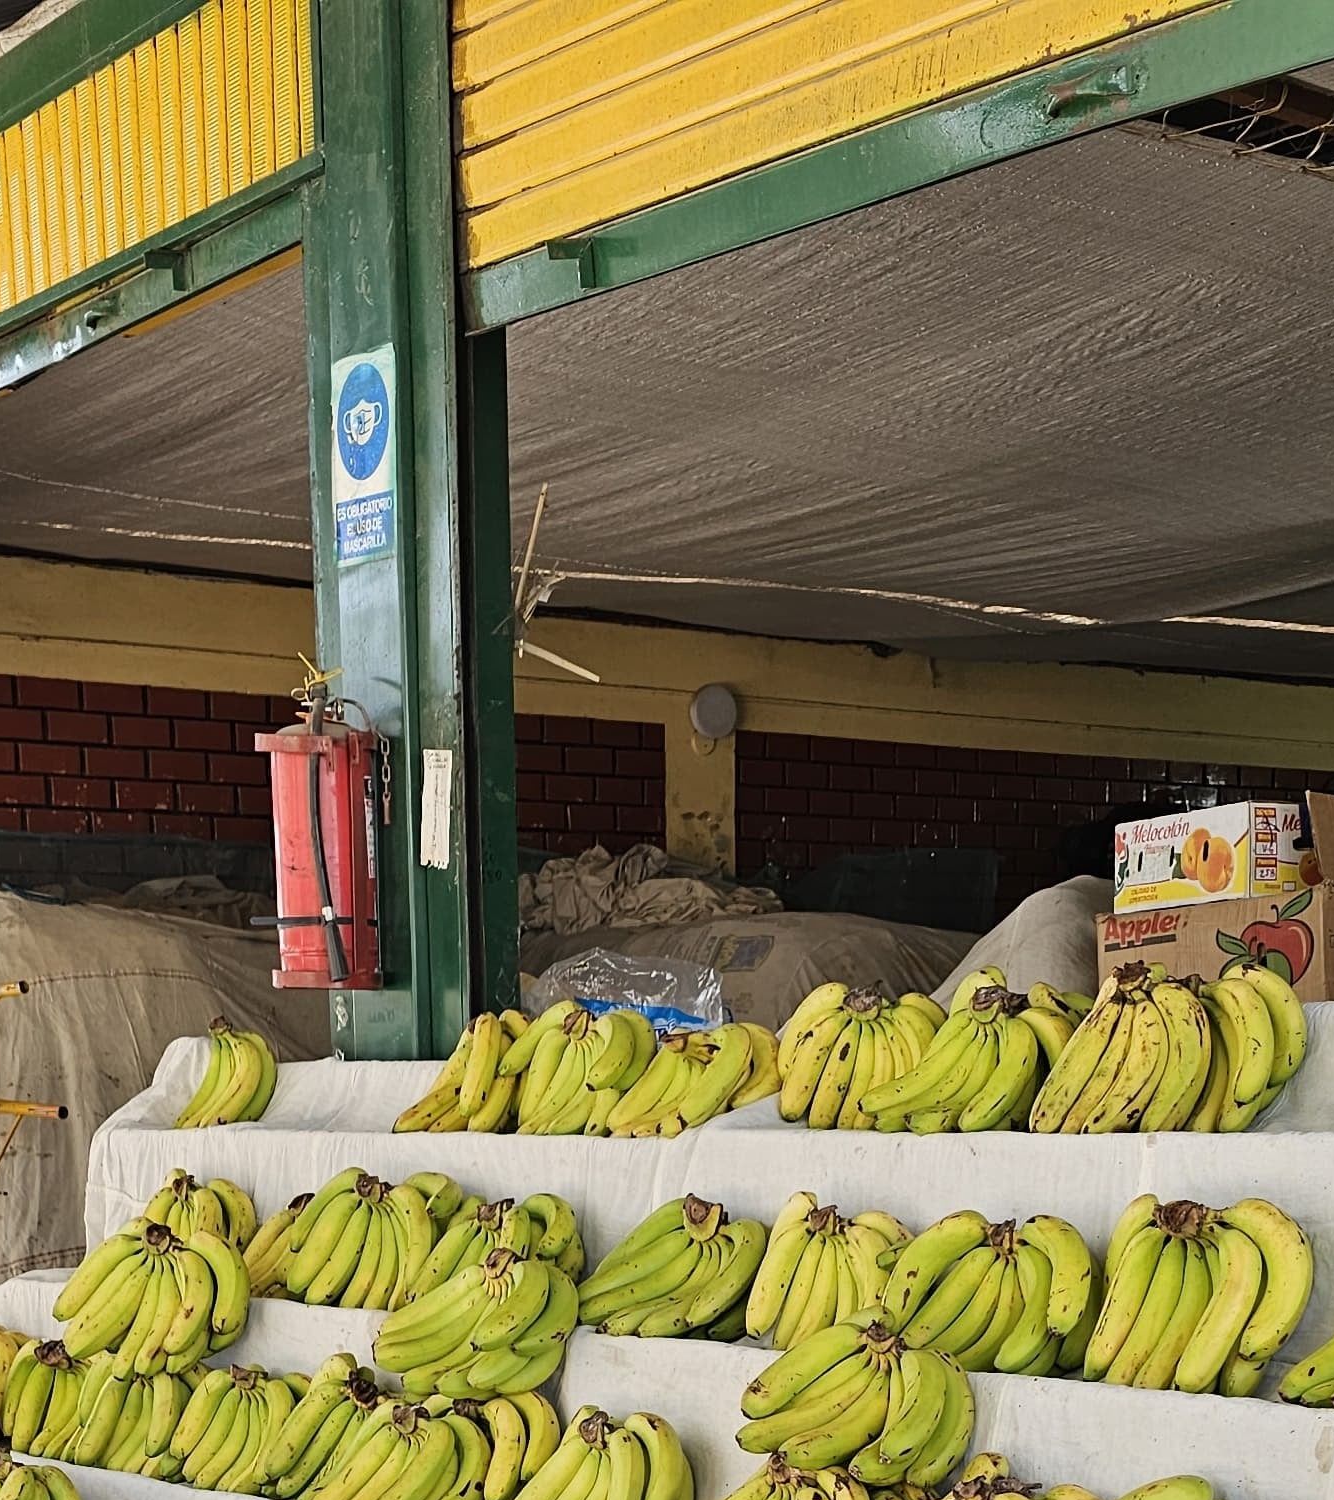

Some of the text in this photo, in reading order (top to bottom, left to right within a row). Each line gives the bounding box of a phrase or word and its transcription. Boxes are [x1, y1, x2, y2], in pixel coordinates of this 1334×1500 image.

[337, 496, 393, 522] ES OBLIGATORIO
[357, 519, 371, 535] USO
[372, 516, 383, 531] DE
[343, 533, 387, 554] MASCARILLA
[1131, 817, 1190, 846] Melocotón
